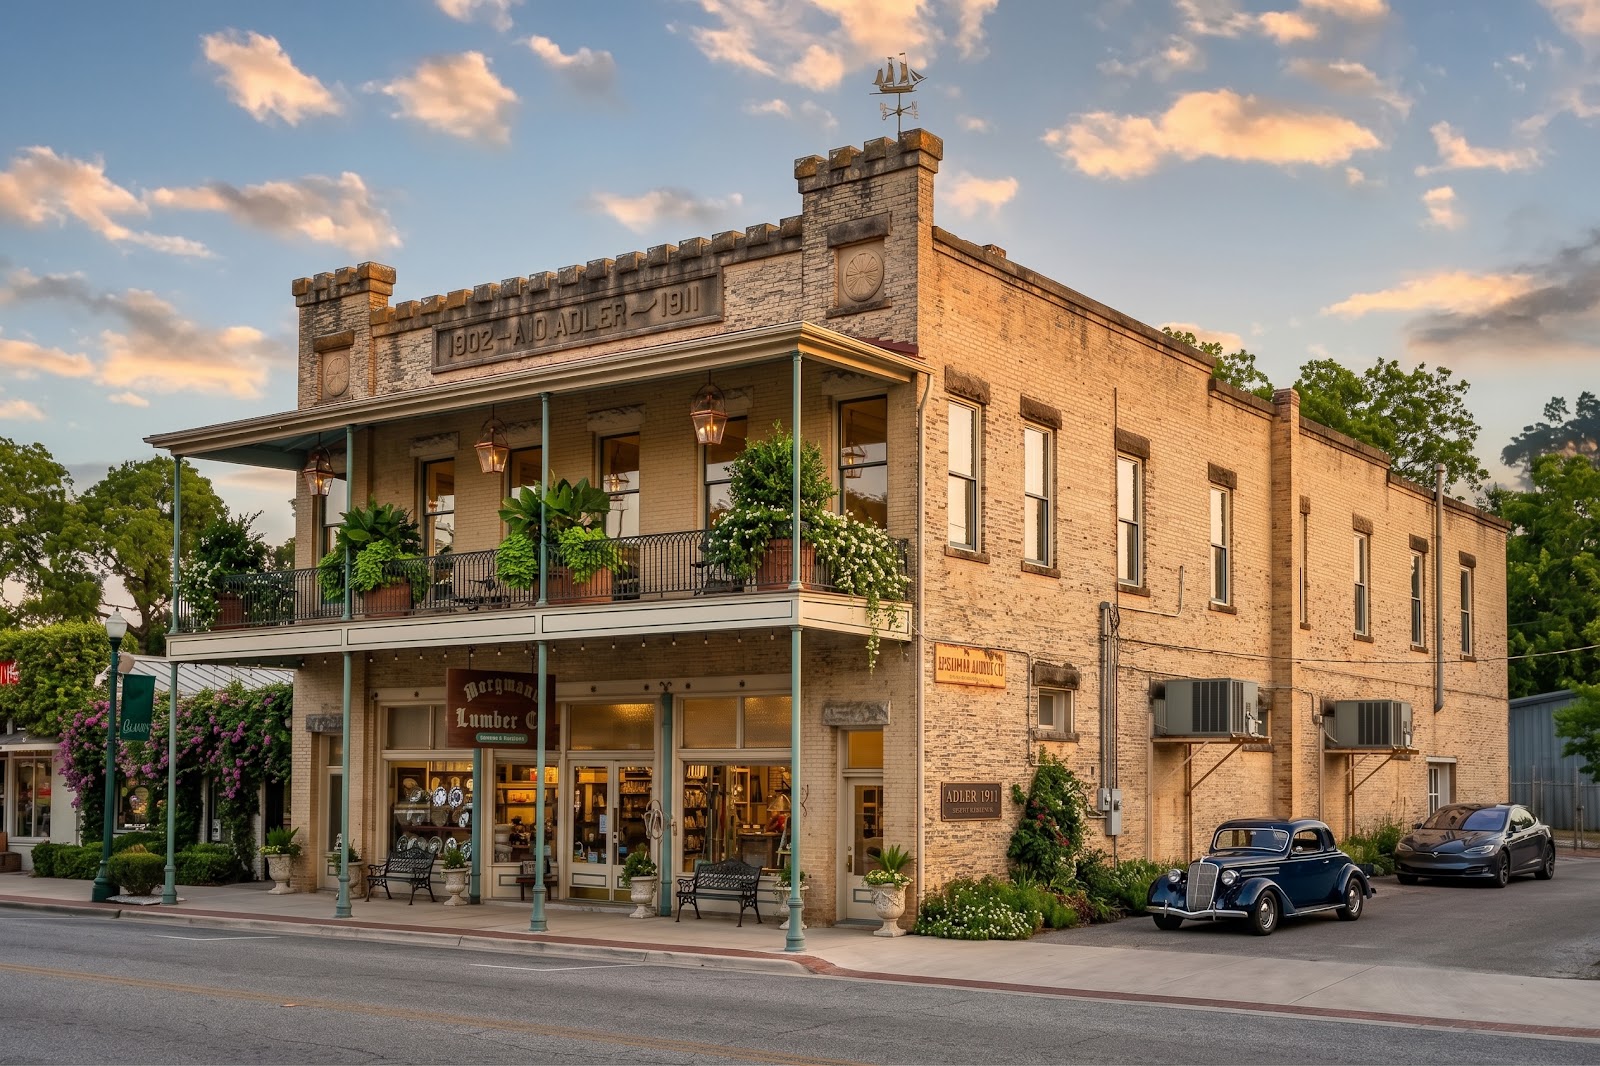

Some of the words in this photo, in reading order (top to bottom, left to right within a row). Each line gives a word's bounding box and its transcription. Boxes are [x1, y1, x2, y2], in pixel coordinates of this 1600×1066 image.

[448, 326, 494, 358] 1902
[553, 300, 627, 338] ADLER
[661, 285, 699, 317] 1911
[455, 707, 518, 729] Lumber
[946, 790, 977, 803] ADLER
[981, 790, 998, 803] 1911
